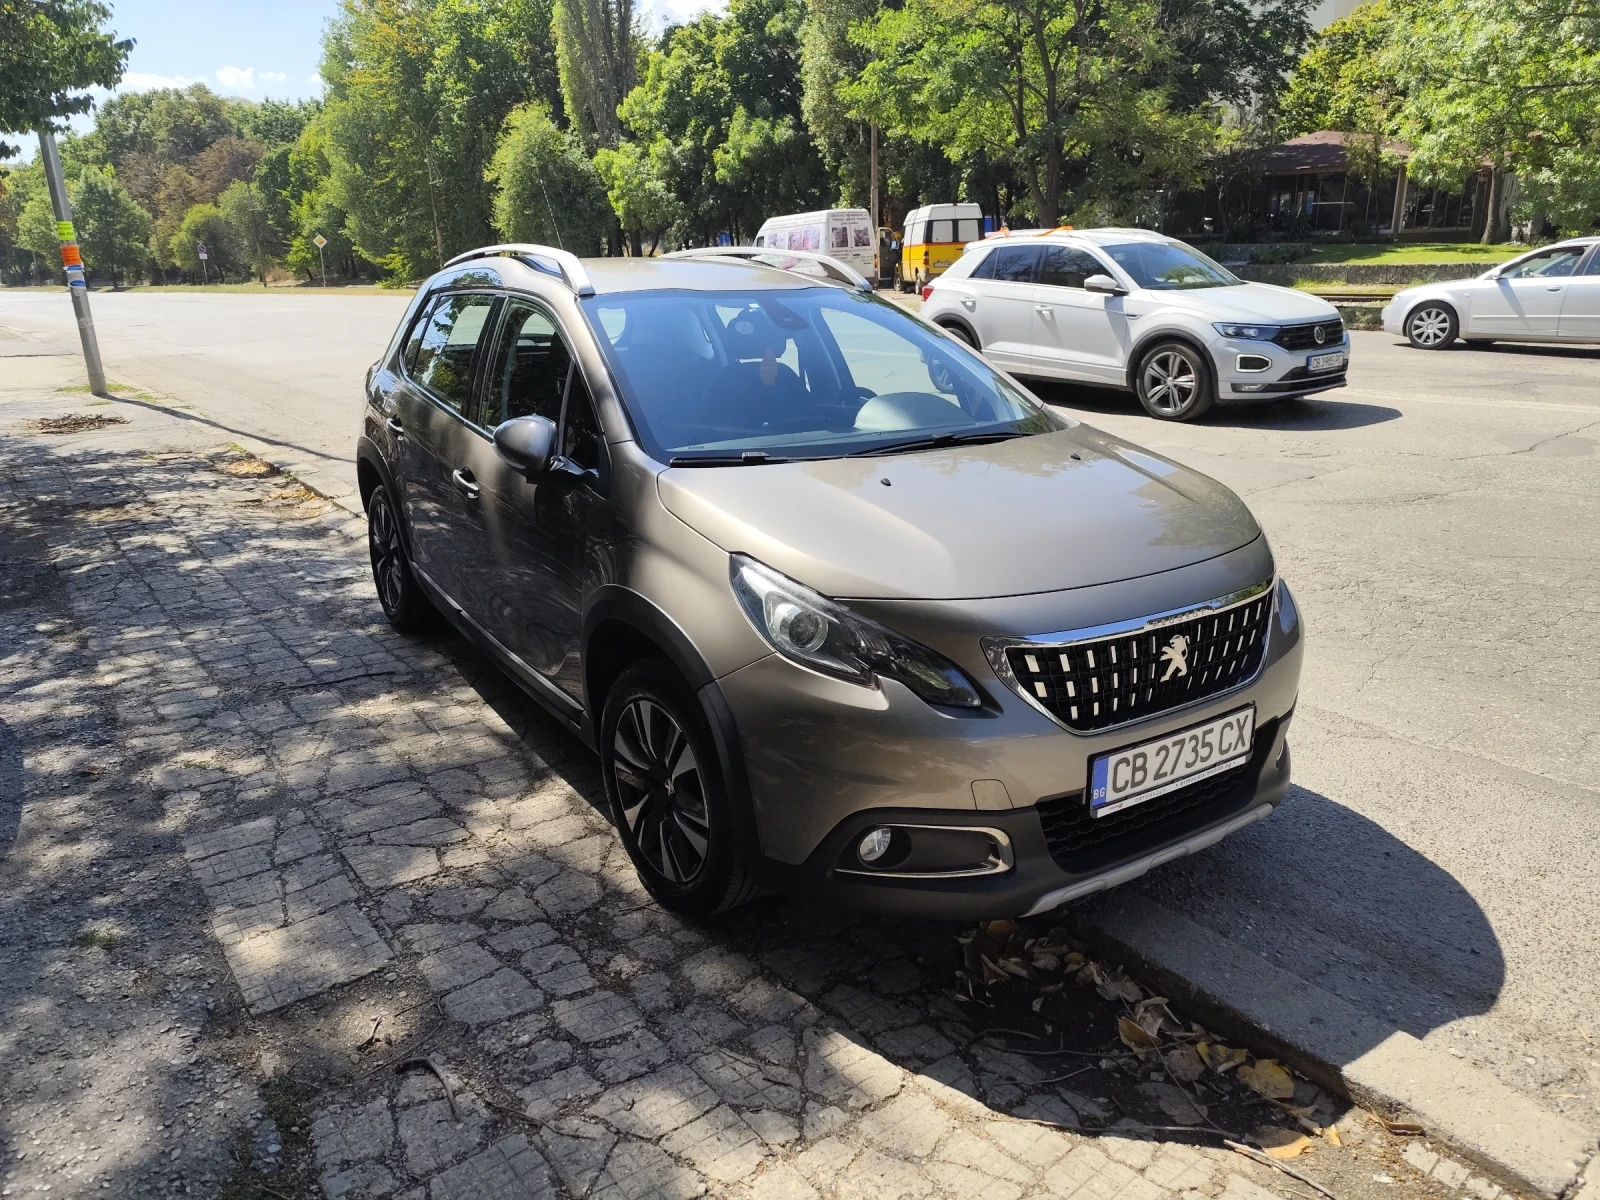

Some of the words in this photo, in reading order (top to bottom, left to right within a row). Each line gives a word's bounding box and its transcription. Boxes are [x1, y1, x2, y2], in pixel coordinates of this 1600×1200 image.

[1152, 608, 1205, 627] PEUGEOT
[1112, 751, 1148, 794] CB
[1153, 727, 1214, 782] 2735
[1218, 714, 1249, 756] CX
[1092, 786, 1106, 800] BG
